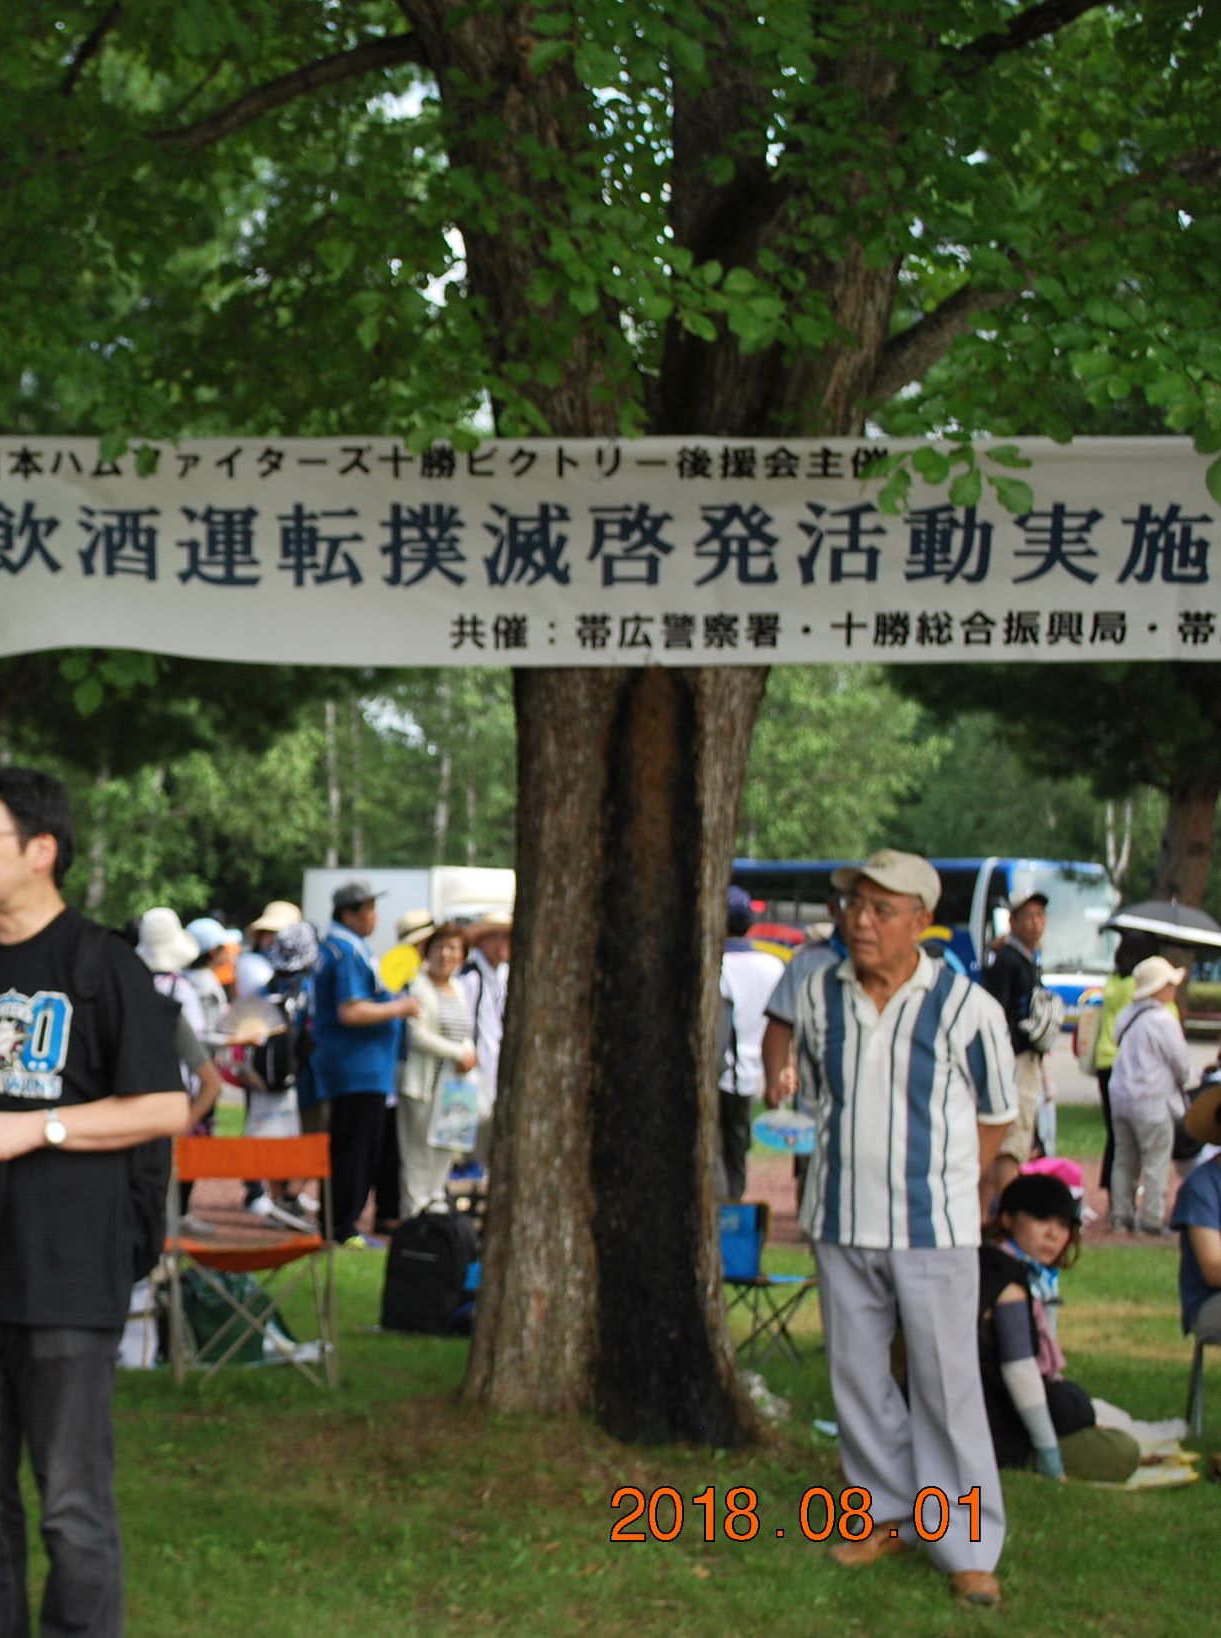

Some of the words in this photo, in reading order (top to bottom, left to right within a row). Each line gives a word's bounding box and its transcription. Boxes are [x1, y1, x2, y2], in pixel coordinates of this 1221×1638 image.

[450, 611, 1221, 650] 共催：帯広警察署・十勝総合振興局・帯
